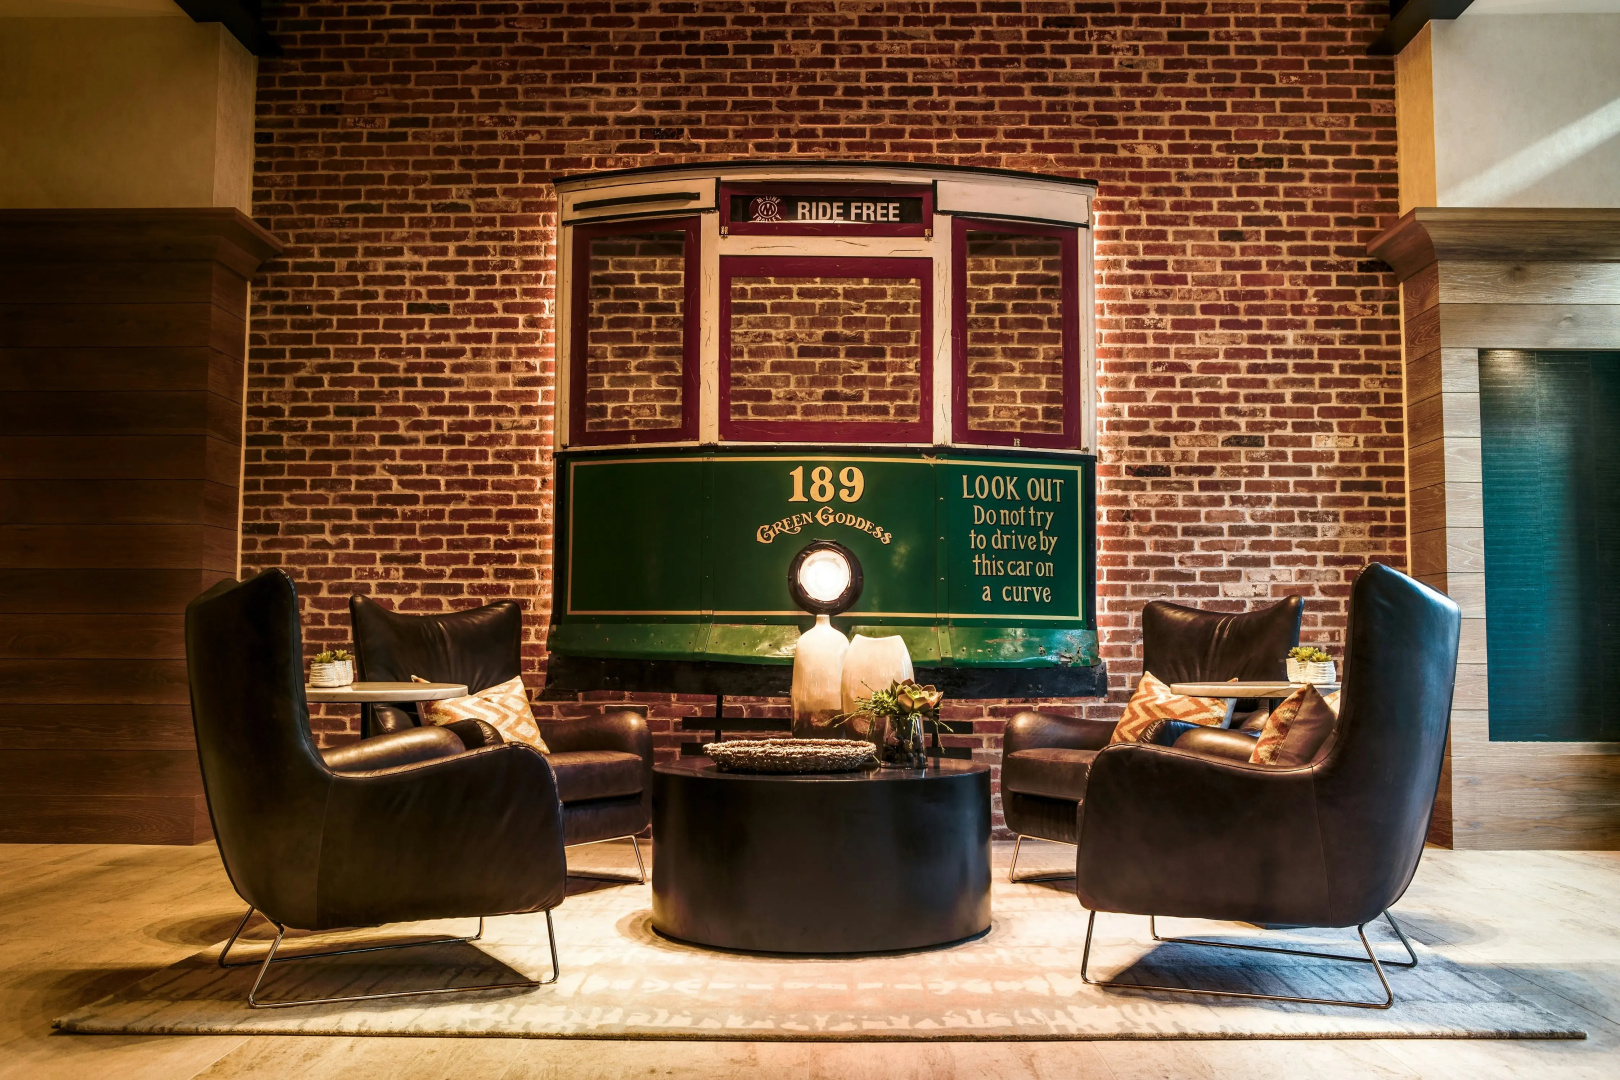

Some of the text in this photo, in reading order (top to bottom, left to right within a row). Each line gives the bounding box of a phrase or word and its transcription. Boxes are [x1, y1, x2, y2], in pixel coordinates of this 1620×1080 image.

[797, 201, 900, 221] RIDE FREE
[787, 465, 865, 503] 189
[962, 474, 1064, 502] LOOK OUT
[756, 505, 893, 545] GREEN GODDESS
[973, 504, 1055, 531] Do not try
[969, 528, 1059, 556] to drive by
[972, 553, 1054, 577] this car on
[981, 585, 1052, 603] a curve
